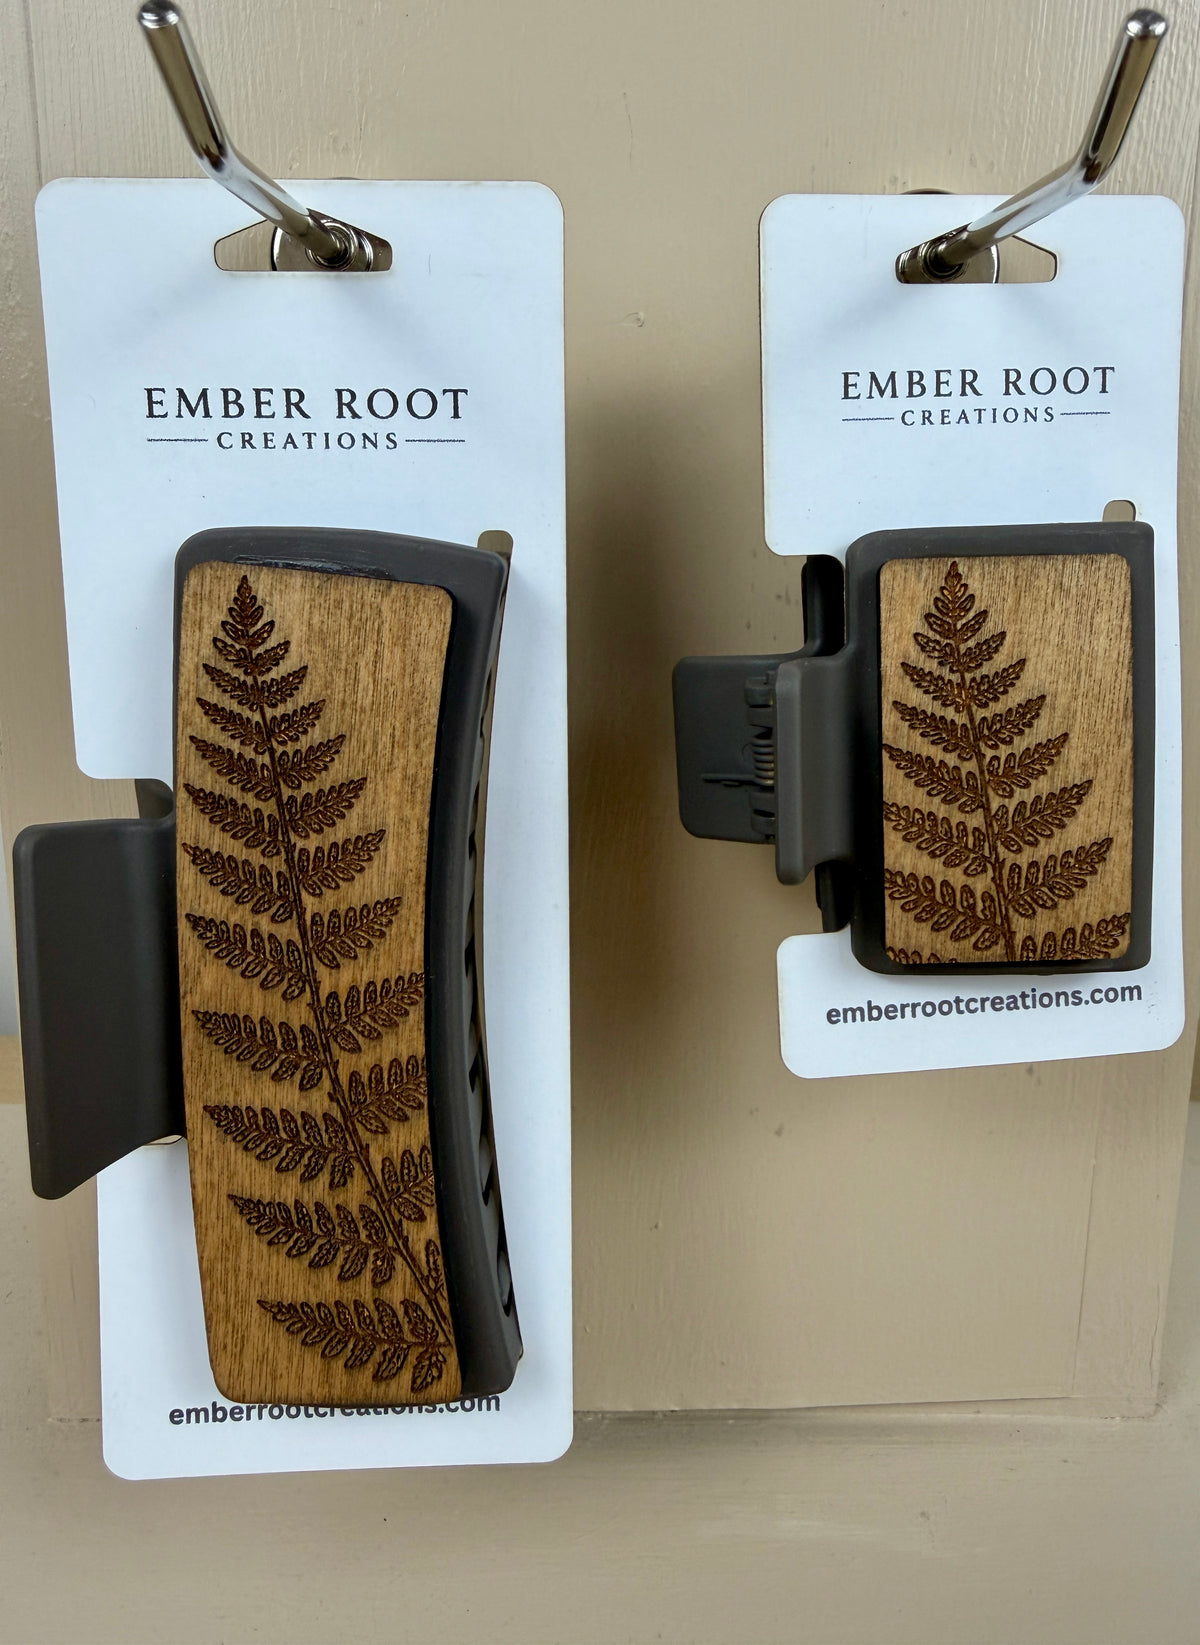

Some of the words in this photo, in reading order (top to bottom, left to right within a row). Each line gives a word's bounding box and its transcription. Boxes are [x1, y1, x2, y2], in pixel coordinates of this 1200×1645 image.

[841, 369, 984, 400] EMBER
[1002, 366, 1116, 397] ROOT
[143, 387, 312, 420] EMBER
[334, 387, 469, 420] ROOT
[900, 406, 1055, 427] CREATIONS
[216, 431, 398, 450] CREATIONS
[826, 984, 1142, 1025] emberrootcreations.com
